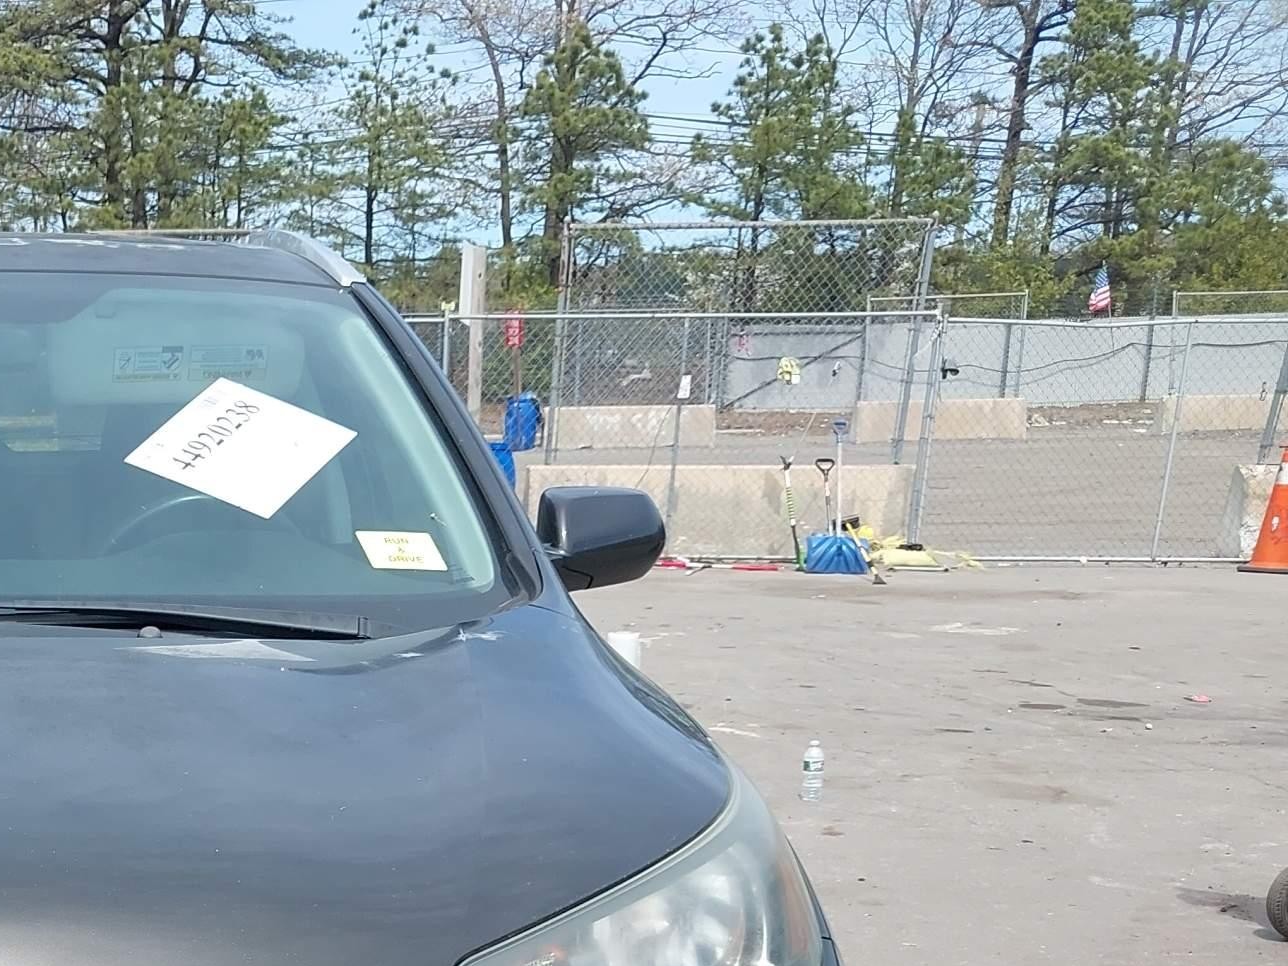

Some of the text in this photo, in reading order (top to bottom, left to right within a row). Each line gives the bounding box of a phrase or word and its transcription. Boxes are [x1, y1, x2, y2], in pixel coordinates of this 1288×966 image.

[172, 400, 260, 471] 44920238
[383, 536, 409, 545] RUN
[387, 555, 425, 564] DRIVE
